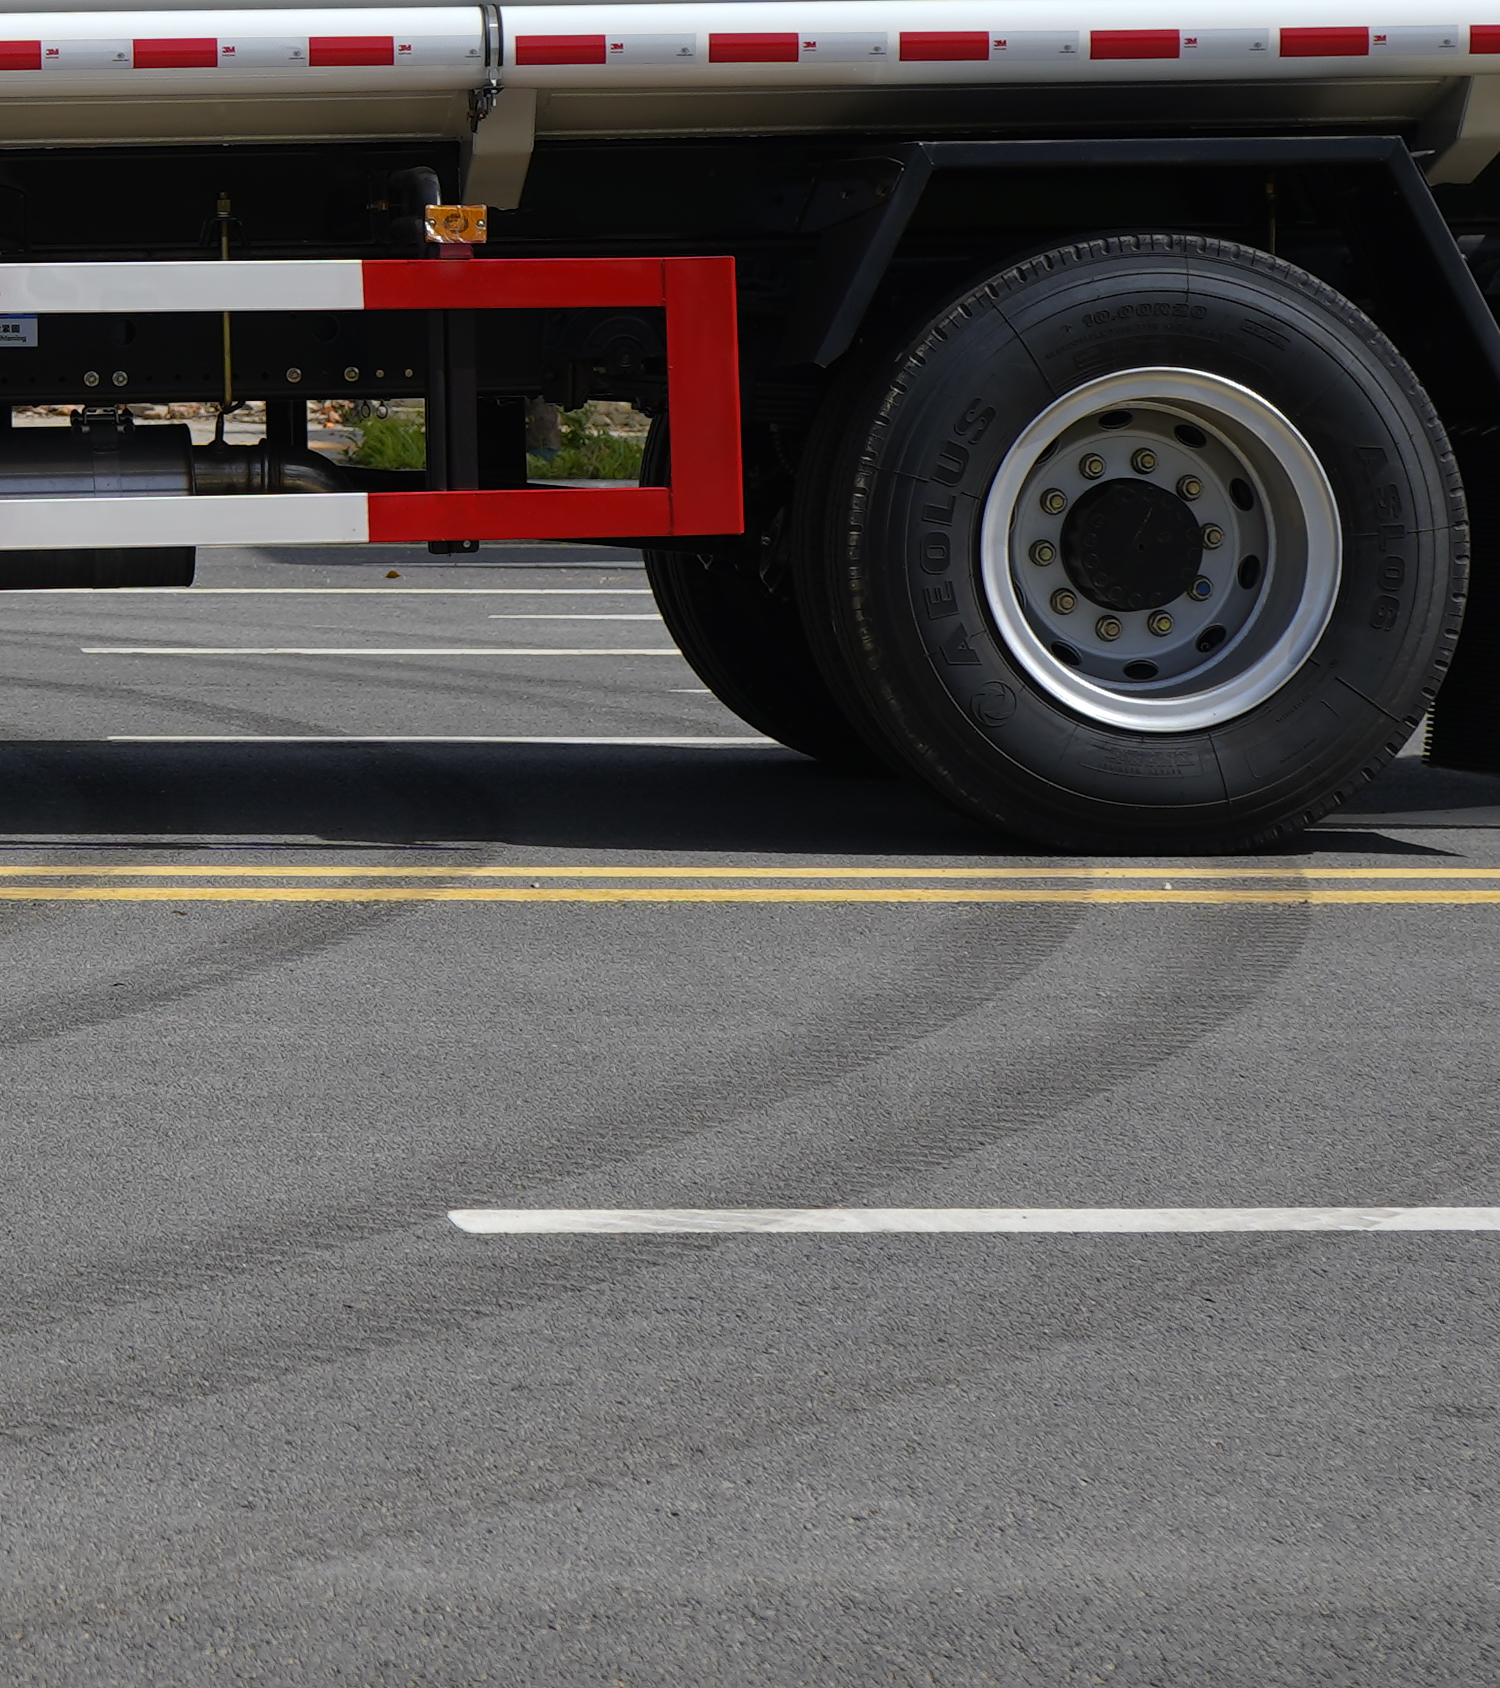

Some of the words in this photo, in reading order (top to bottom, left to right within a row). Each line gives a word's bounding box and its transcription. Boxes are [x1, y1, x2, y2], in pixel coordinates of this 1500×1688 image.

[1082, 303, 1208, 329] 10.00R20
[921, 395, 998, 669] AEOLUS
[1356, 442, 1405, 634] ASL06
